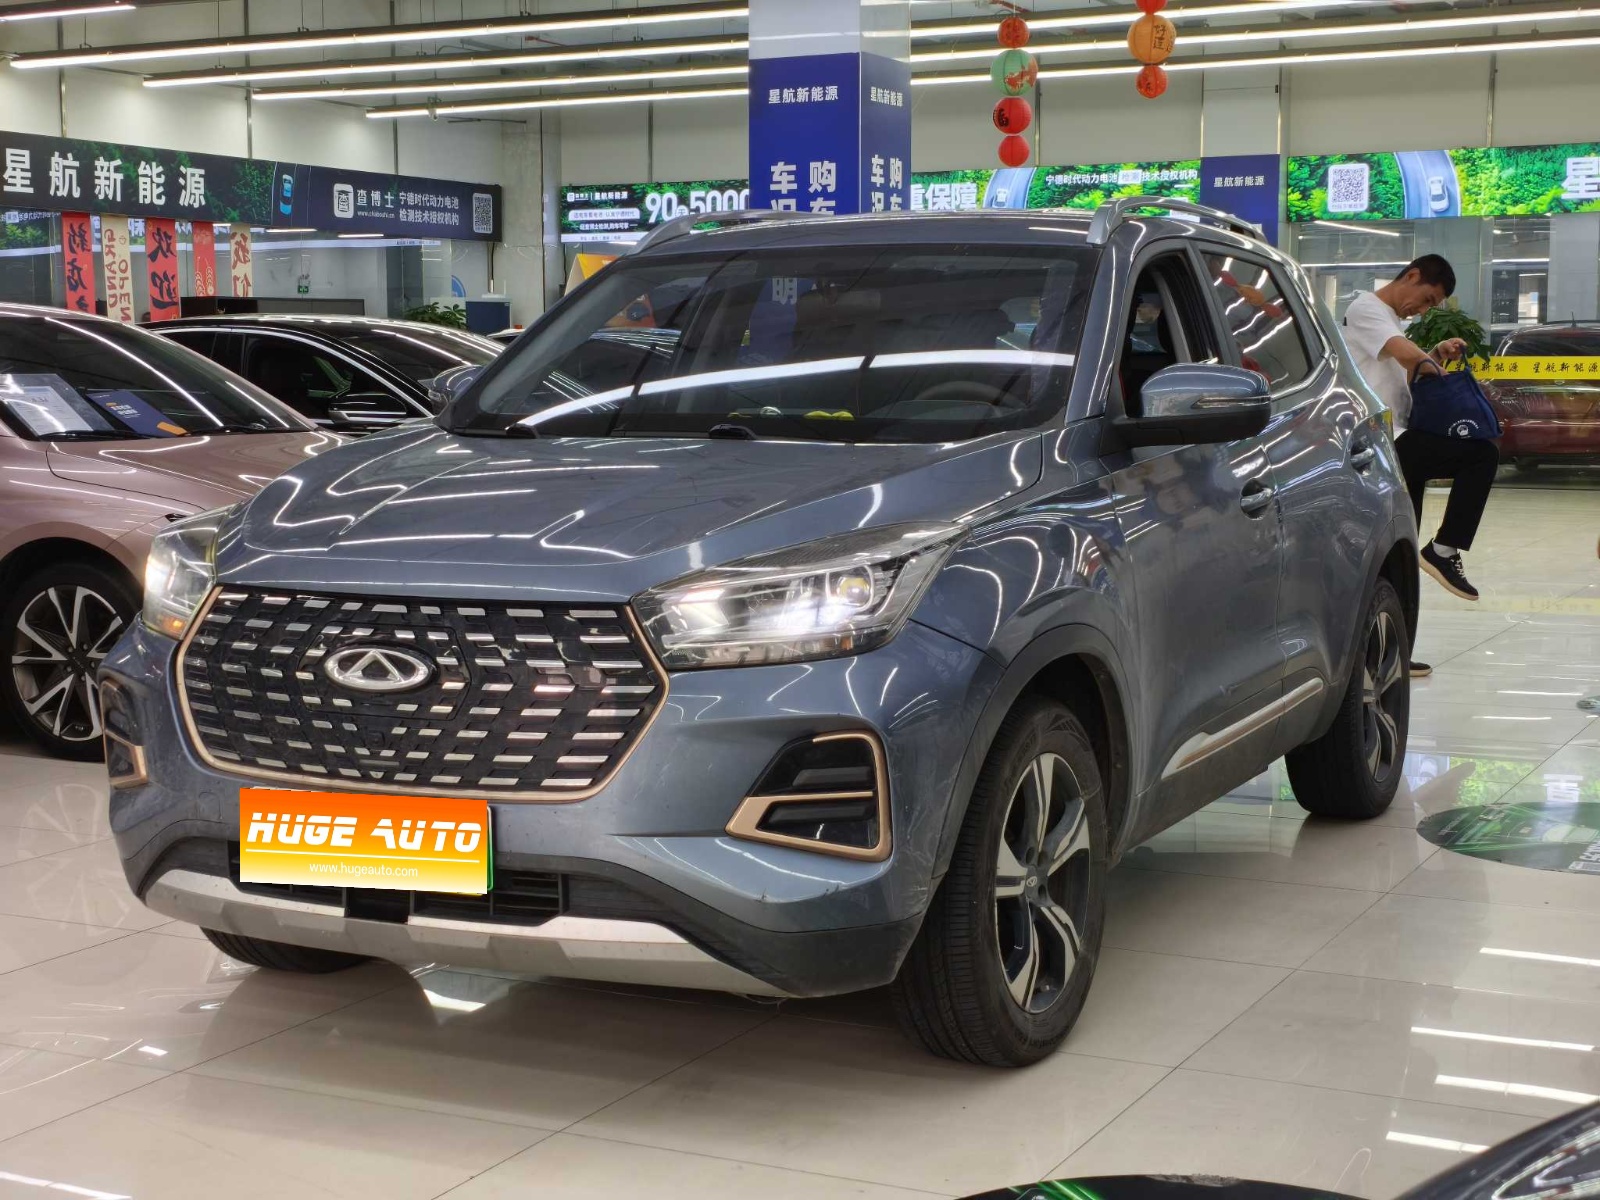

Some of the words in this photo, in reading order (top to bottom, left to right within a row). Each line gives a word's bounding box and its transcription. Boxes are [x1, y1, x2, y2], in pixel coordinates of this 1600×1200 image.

[768, 86, 838, 104] 星航新能源
[870, 87, 903, 107] 星航新能源
[3, 148, 206, 209] 星航新能源
[1214, 176, 1265, 188] 星航新能源
[356, 189, 395, 208] 查博士
[399, 191, 459, 209] 宁德时代动力电池
[399, 208, 459, 226] 检测技术授权机构
